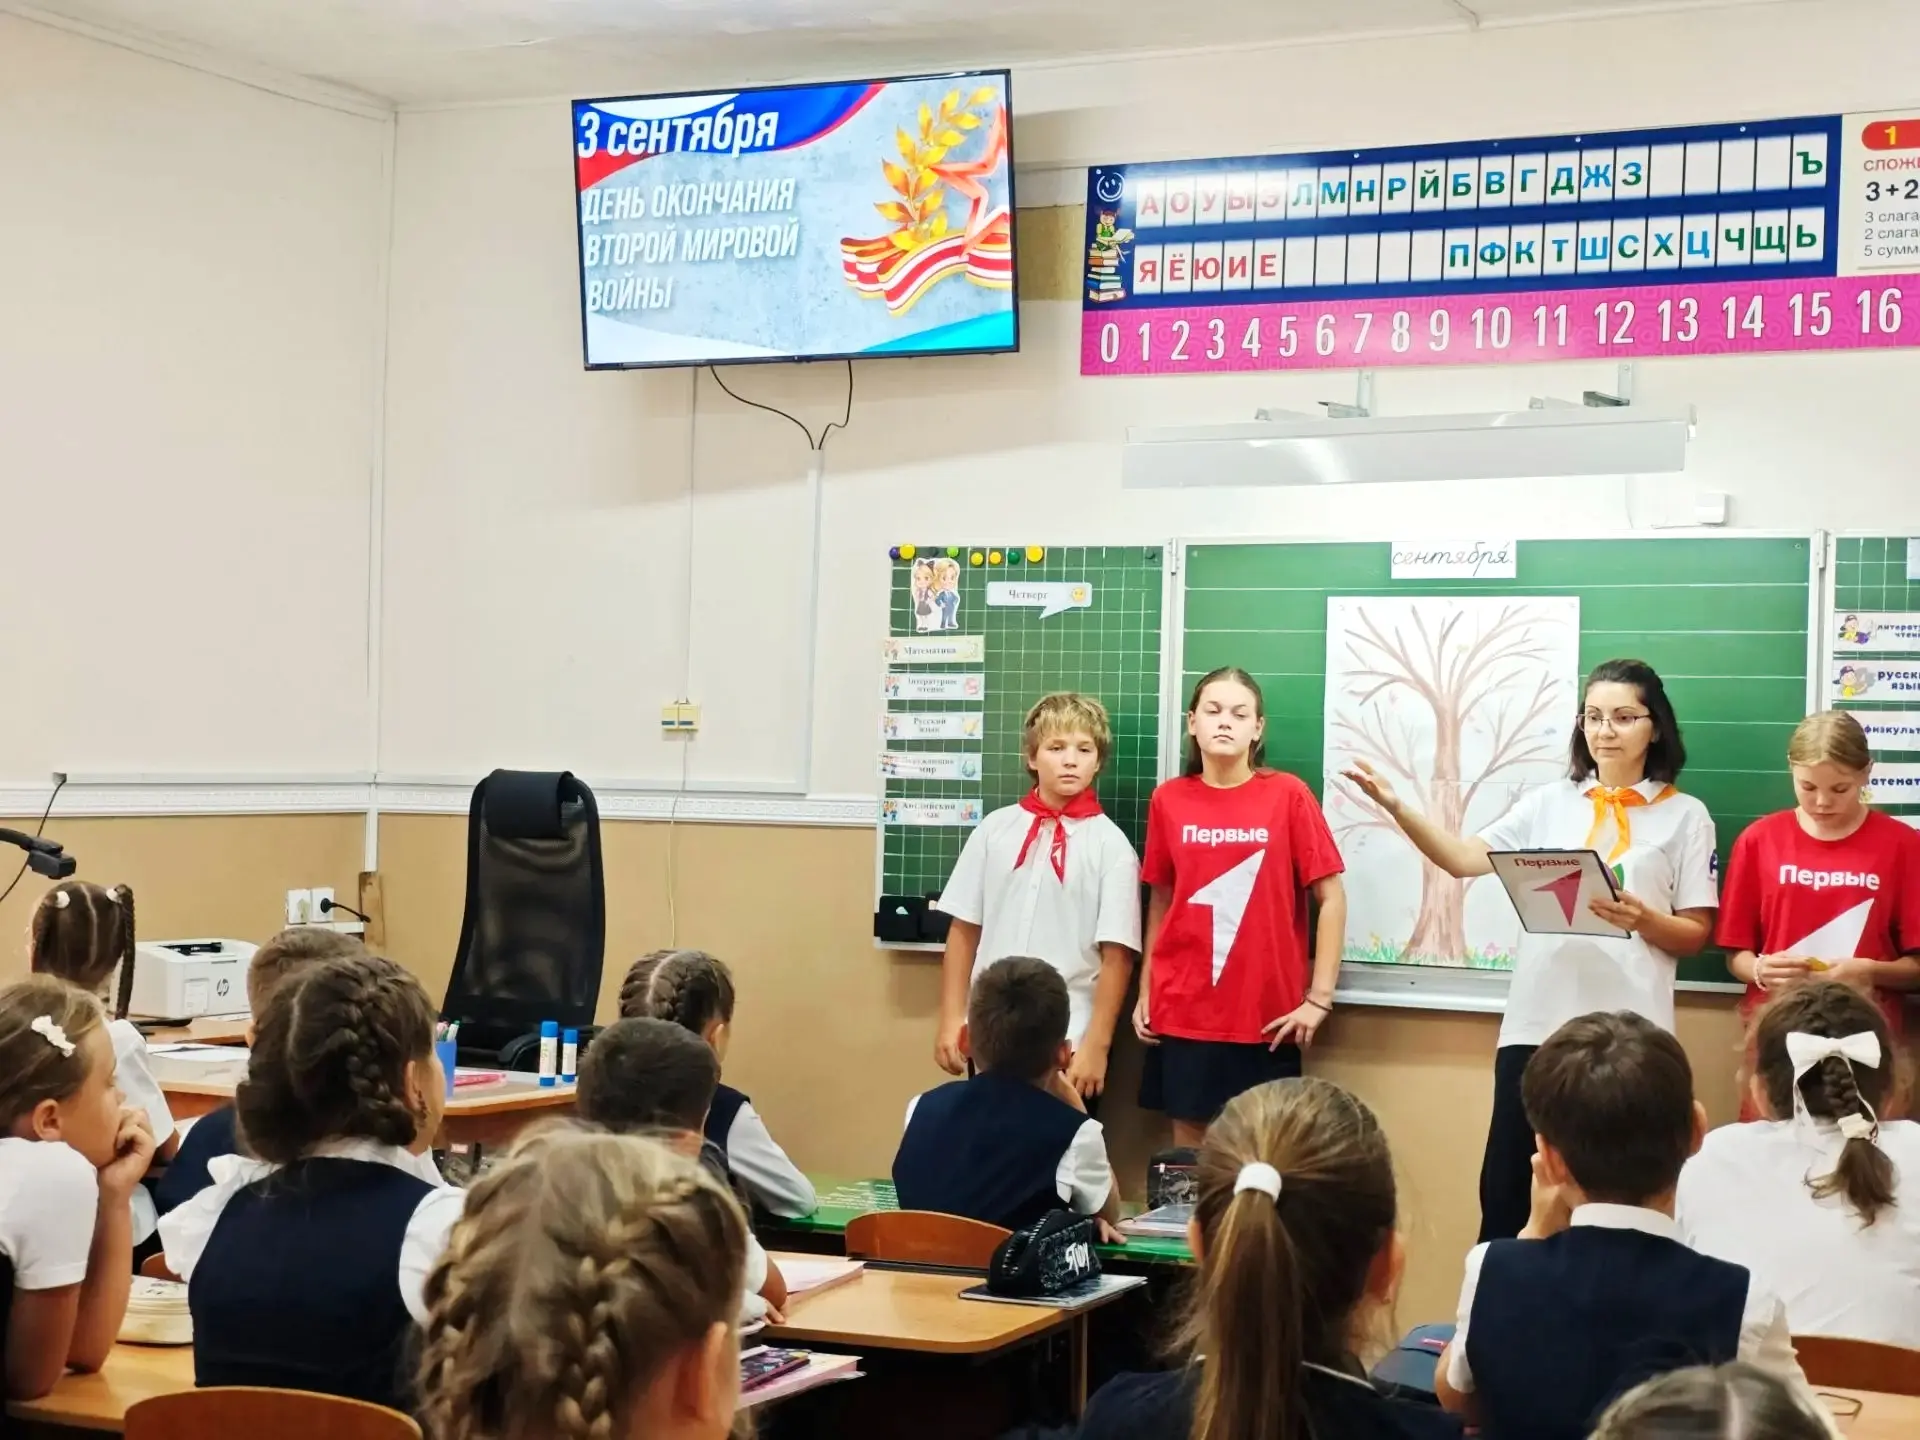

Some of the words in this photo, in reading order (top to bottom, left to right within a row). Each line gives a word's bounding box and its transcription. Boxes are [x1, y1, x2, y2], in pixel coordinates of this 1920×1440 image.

[579, 112, 599, 157] 3
[607, 103, 778, 158] сентября
[1884, 125, 1897, 146] 1
[583, 188, 645, 225] ДЕНЬ
[653, 178, 796, 218] ОКОНЧАНИЯ
[1865, 211, 1874, 223] 3
[1878, 211, 1920, 223] слага
[586, 224, 677, 267] ВТОРОЙ
[682, 219, 800, 261] МИРОВОЙ
[1864, 228, 1873, 240] 2
[1877, 228, 1920, 239] слага
[1864, 244, 1873, 257] 5
[1877, 245, 1920, 258] сумм
[588, 272, 673, 312] ВОЙНЫ
[1100, 323, 1120, 363] 0
[1138, 322, 1150, 361] 1
[1170, 320, 1190, 360] 2
[1206, 318, 1225, 360] 3
[1241, 317, 1262, 358] 4
[1279, 316, 1298, 357] 5
[1316, 314, 1336, 356] 6
[1353, 312, 1373, 353] 7
[1391, 310, 1411, 352] 8
[1429, 308, 1450, 351] 9
[1471, 306, 1512, 348] 10
[1533, 304, 1567, 349] 11
[1594, 300, 1636, 345] 12
[1657, 297, 1699, 343] 13
[1722, 295, 1765, 339] 14
[1788, 291, 1832, 337] 15
[1857, 287, 1902, 334] 16
[1008, 589, 1048, 602] Четверг
[1877, 671, 1920, 681] русск
[1868, 778, 1920, 786] атемат
[1182, 824, 1269, 847] Первые
[1514, 858, 1581, 870] Первые
[1779, 864, 1880, 891] Первые
